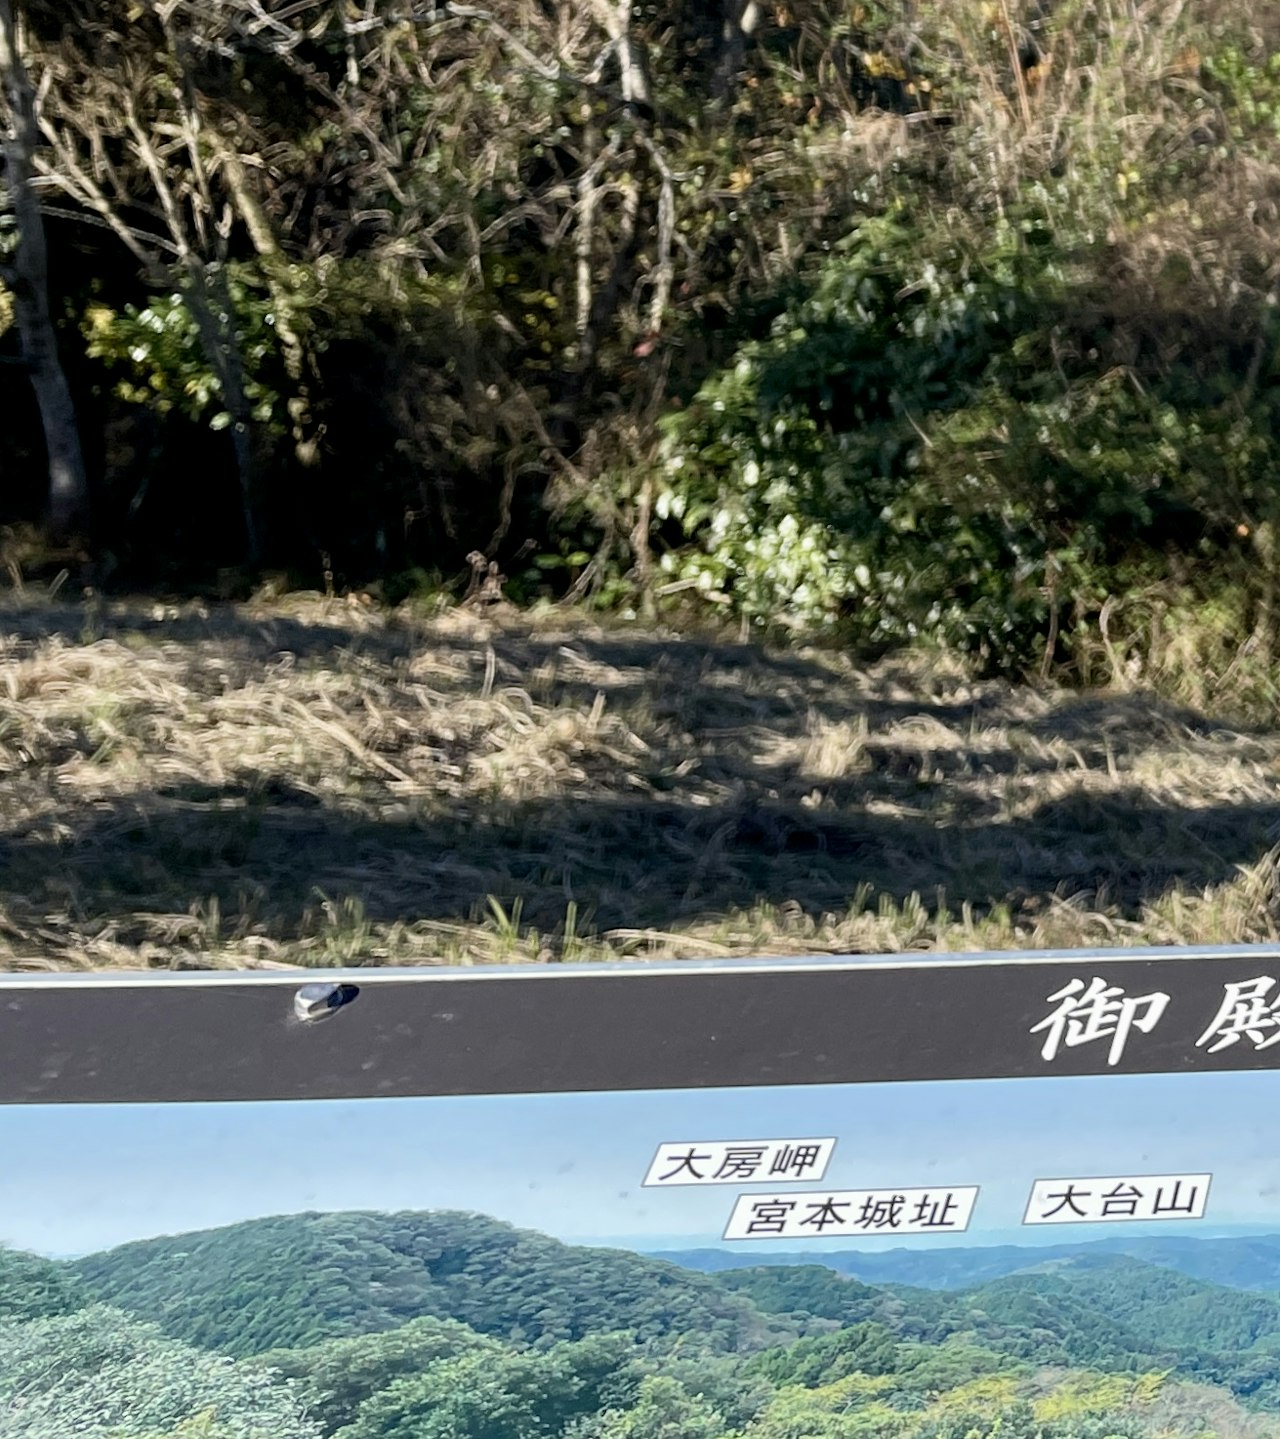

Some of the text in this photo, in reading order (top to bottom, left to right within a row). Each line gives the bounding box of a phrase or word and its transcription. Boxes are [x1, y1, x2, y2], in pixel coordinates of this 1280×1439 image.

[659, 1144, 823, 1181] 大房岬
[745, 1193, 959, 1235] 宮本城址
[1041, 1180, 1199, 1219] 大台山
